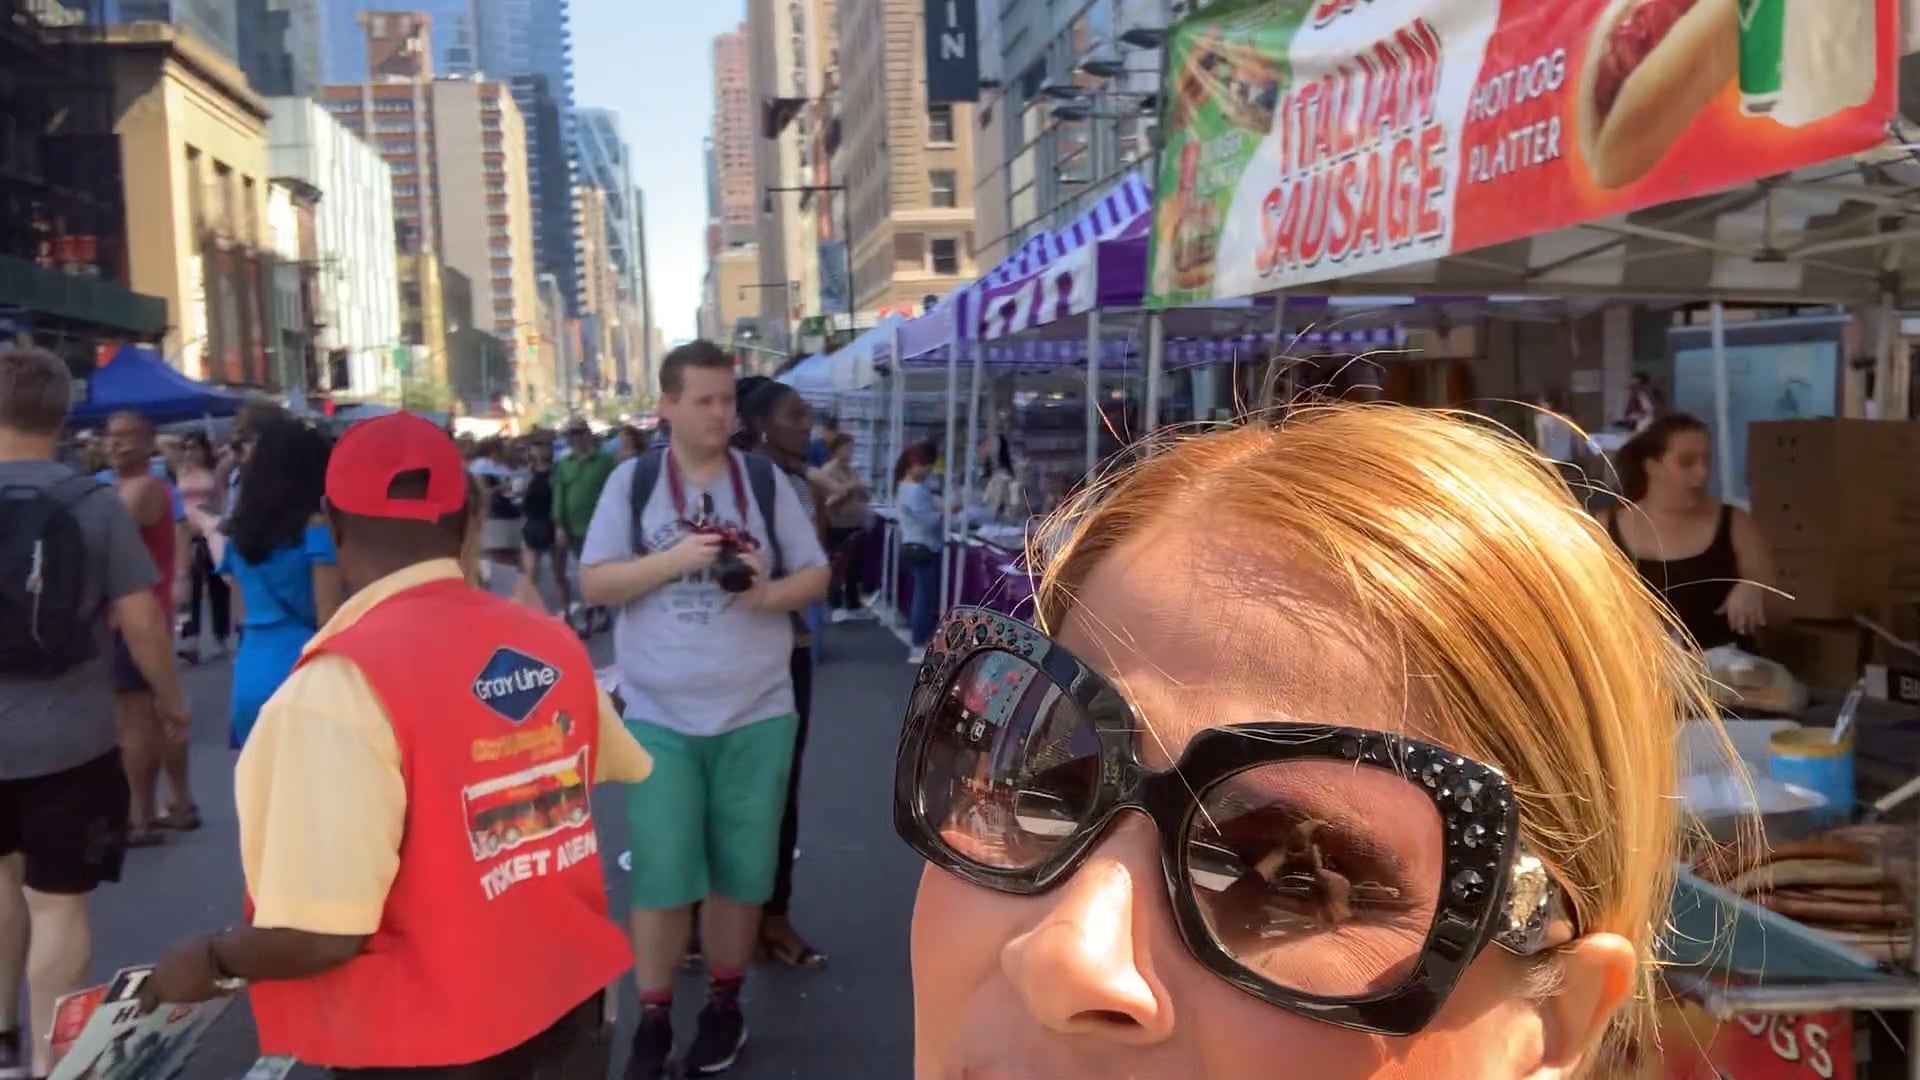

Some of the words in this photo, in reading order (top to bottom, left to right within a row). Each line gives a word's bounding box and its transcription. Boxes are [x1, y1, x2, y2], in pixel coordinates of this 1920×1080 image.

[1280, 16, 1441, 182] ITALIAN
[1469, 70, 1515, 122] HOT
[1515, 48, 1566, 104] DOG
[1468, 115, 1561, 184] PLATTER
[1255, 122, 1447, 277] SAUSAGE
[514, 667, 555, 691] Line
